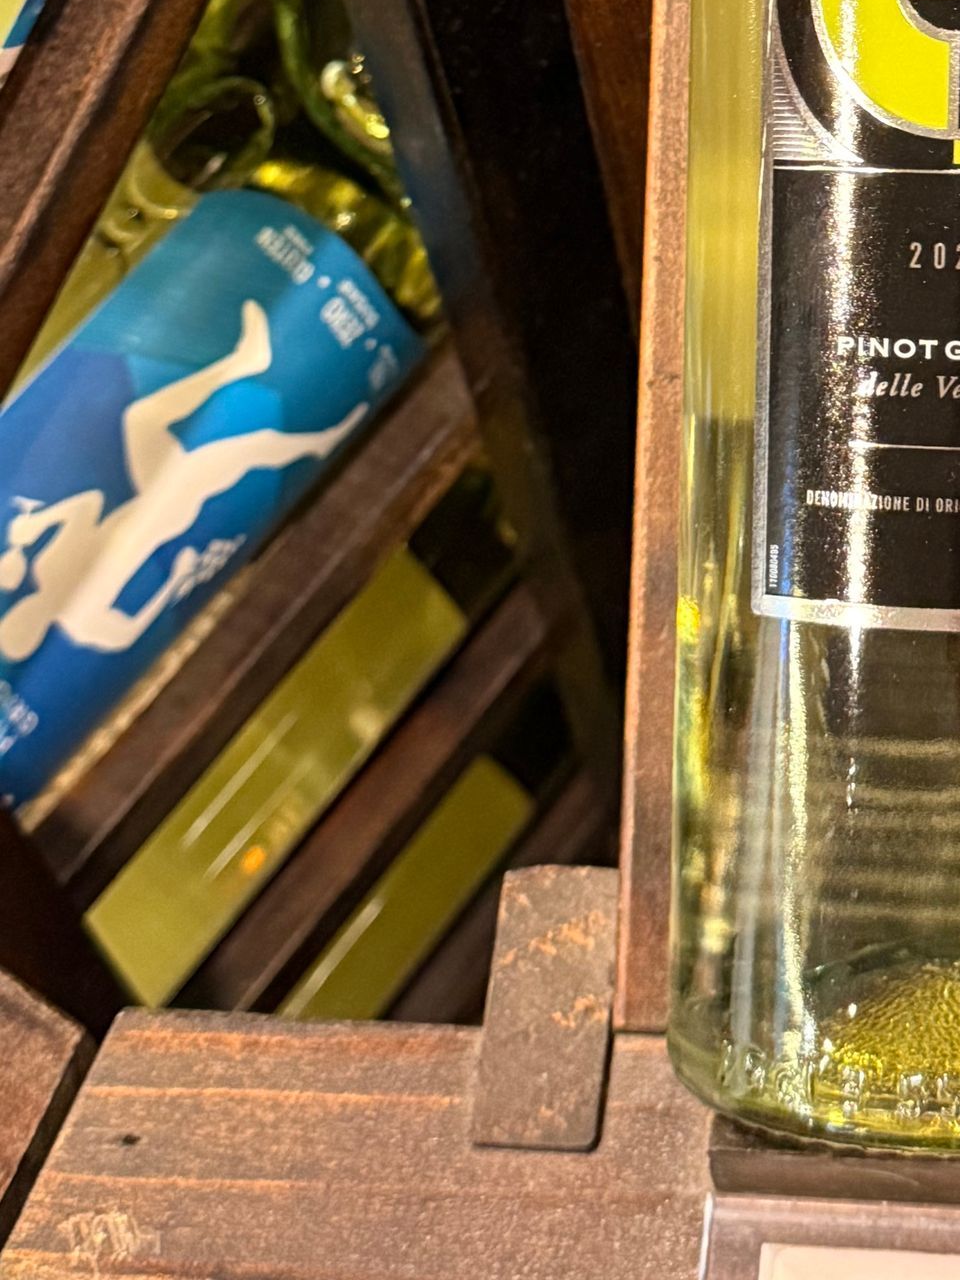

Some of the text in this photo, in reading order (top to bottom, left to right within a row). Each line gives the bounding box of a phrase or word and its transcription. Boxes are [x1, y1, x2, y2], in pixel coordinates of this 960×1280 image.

[837, 336, 939, 361] PINOT
[856, 370, 924, 399] delle
[916, 495, 931, 513] DI
